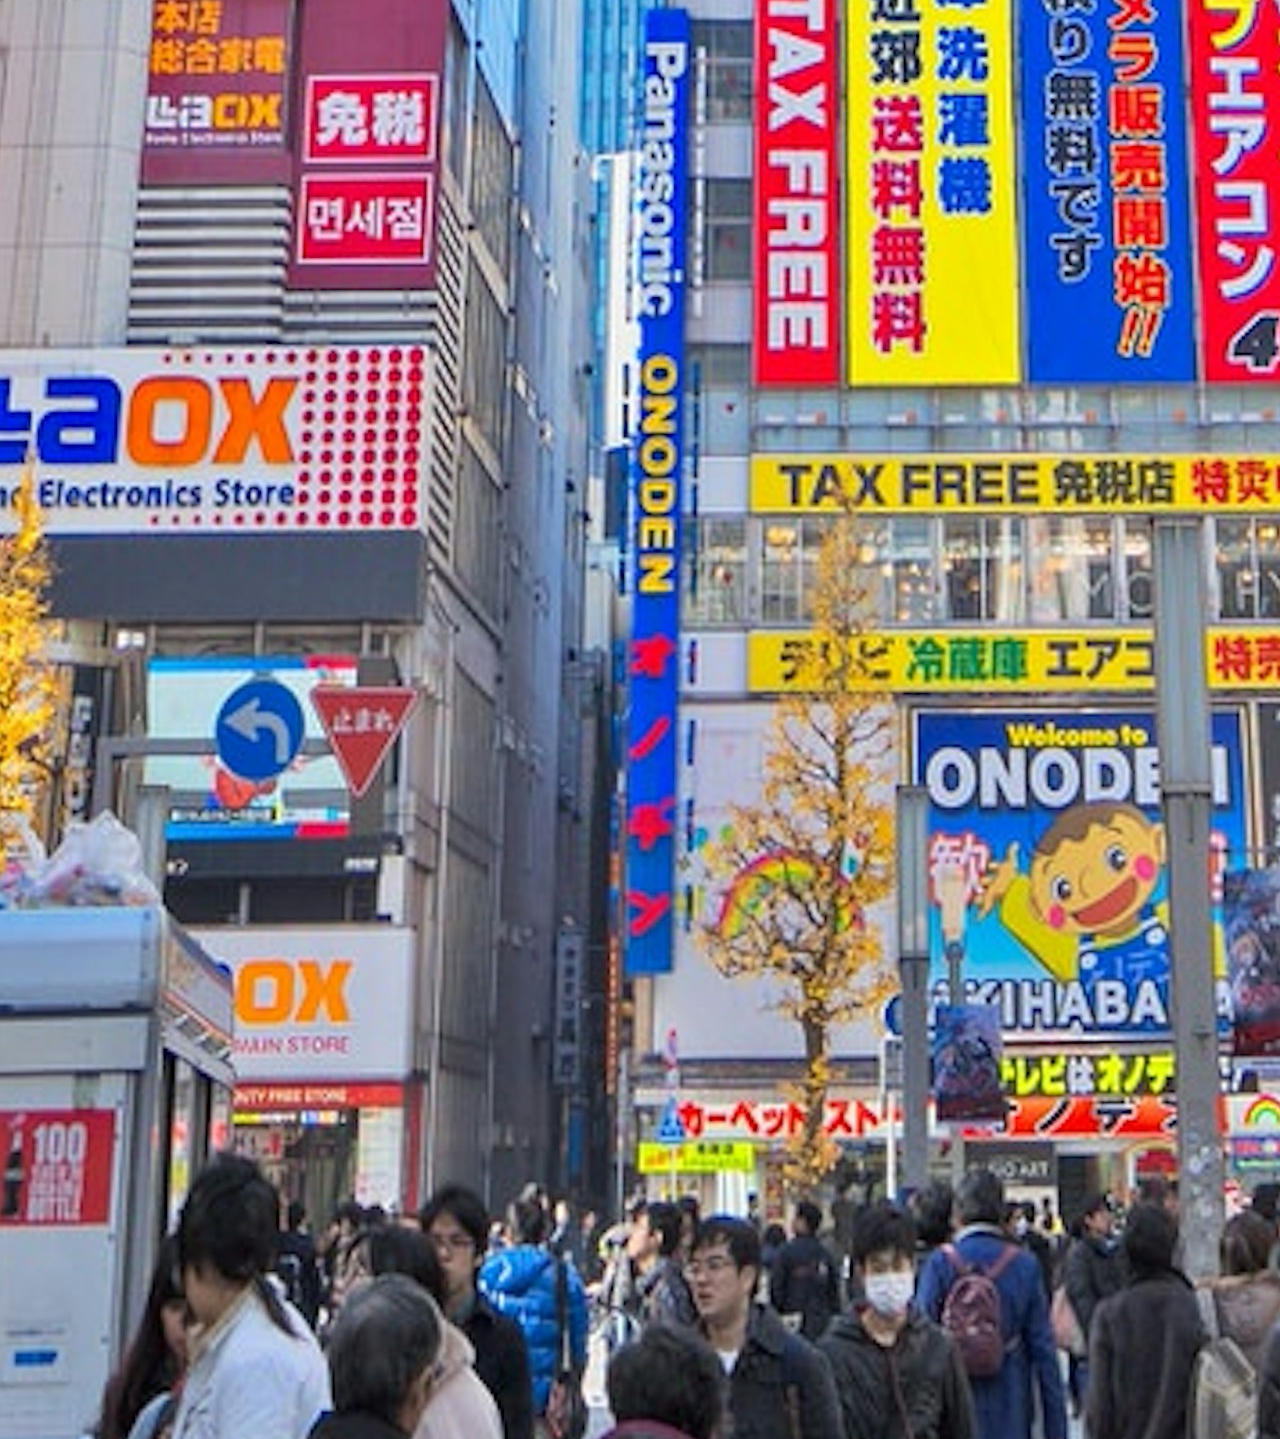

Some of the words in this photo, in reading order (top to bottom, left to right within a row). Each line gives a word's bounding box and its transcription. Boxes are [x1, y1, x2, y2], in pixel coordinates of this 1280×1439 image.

[151, 35, 286, 75] 総合家電
[315, 89, 429, 150] 免税
[642, 37, 687, 318] Panasonic
[305, 196, 425, 245] 면세점
[766, 152, 830, 353] FREE
[35, 474, 207, 512] Electronics
[213, 472, 297, 511] Store
[637, 354, 679, 595] ONODEN
[780, 462, 886, 507] TAX
[900, 463, 1041, 507] FREE
[1052, 462, 1177, 506] 免税店
[905, 636, 1029, 682] 冷蔵庫
[331, 705, 395, 733] 止まれ
[1007, 724, 1119, 748] Welcome
[1121, 723, 1148, 746] to
[626, 634, 677, 938] オノデン
[285, 1036, 351, 1054] STORE
[30, 1121, 89, 1164] 100
